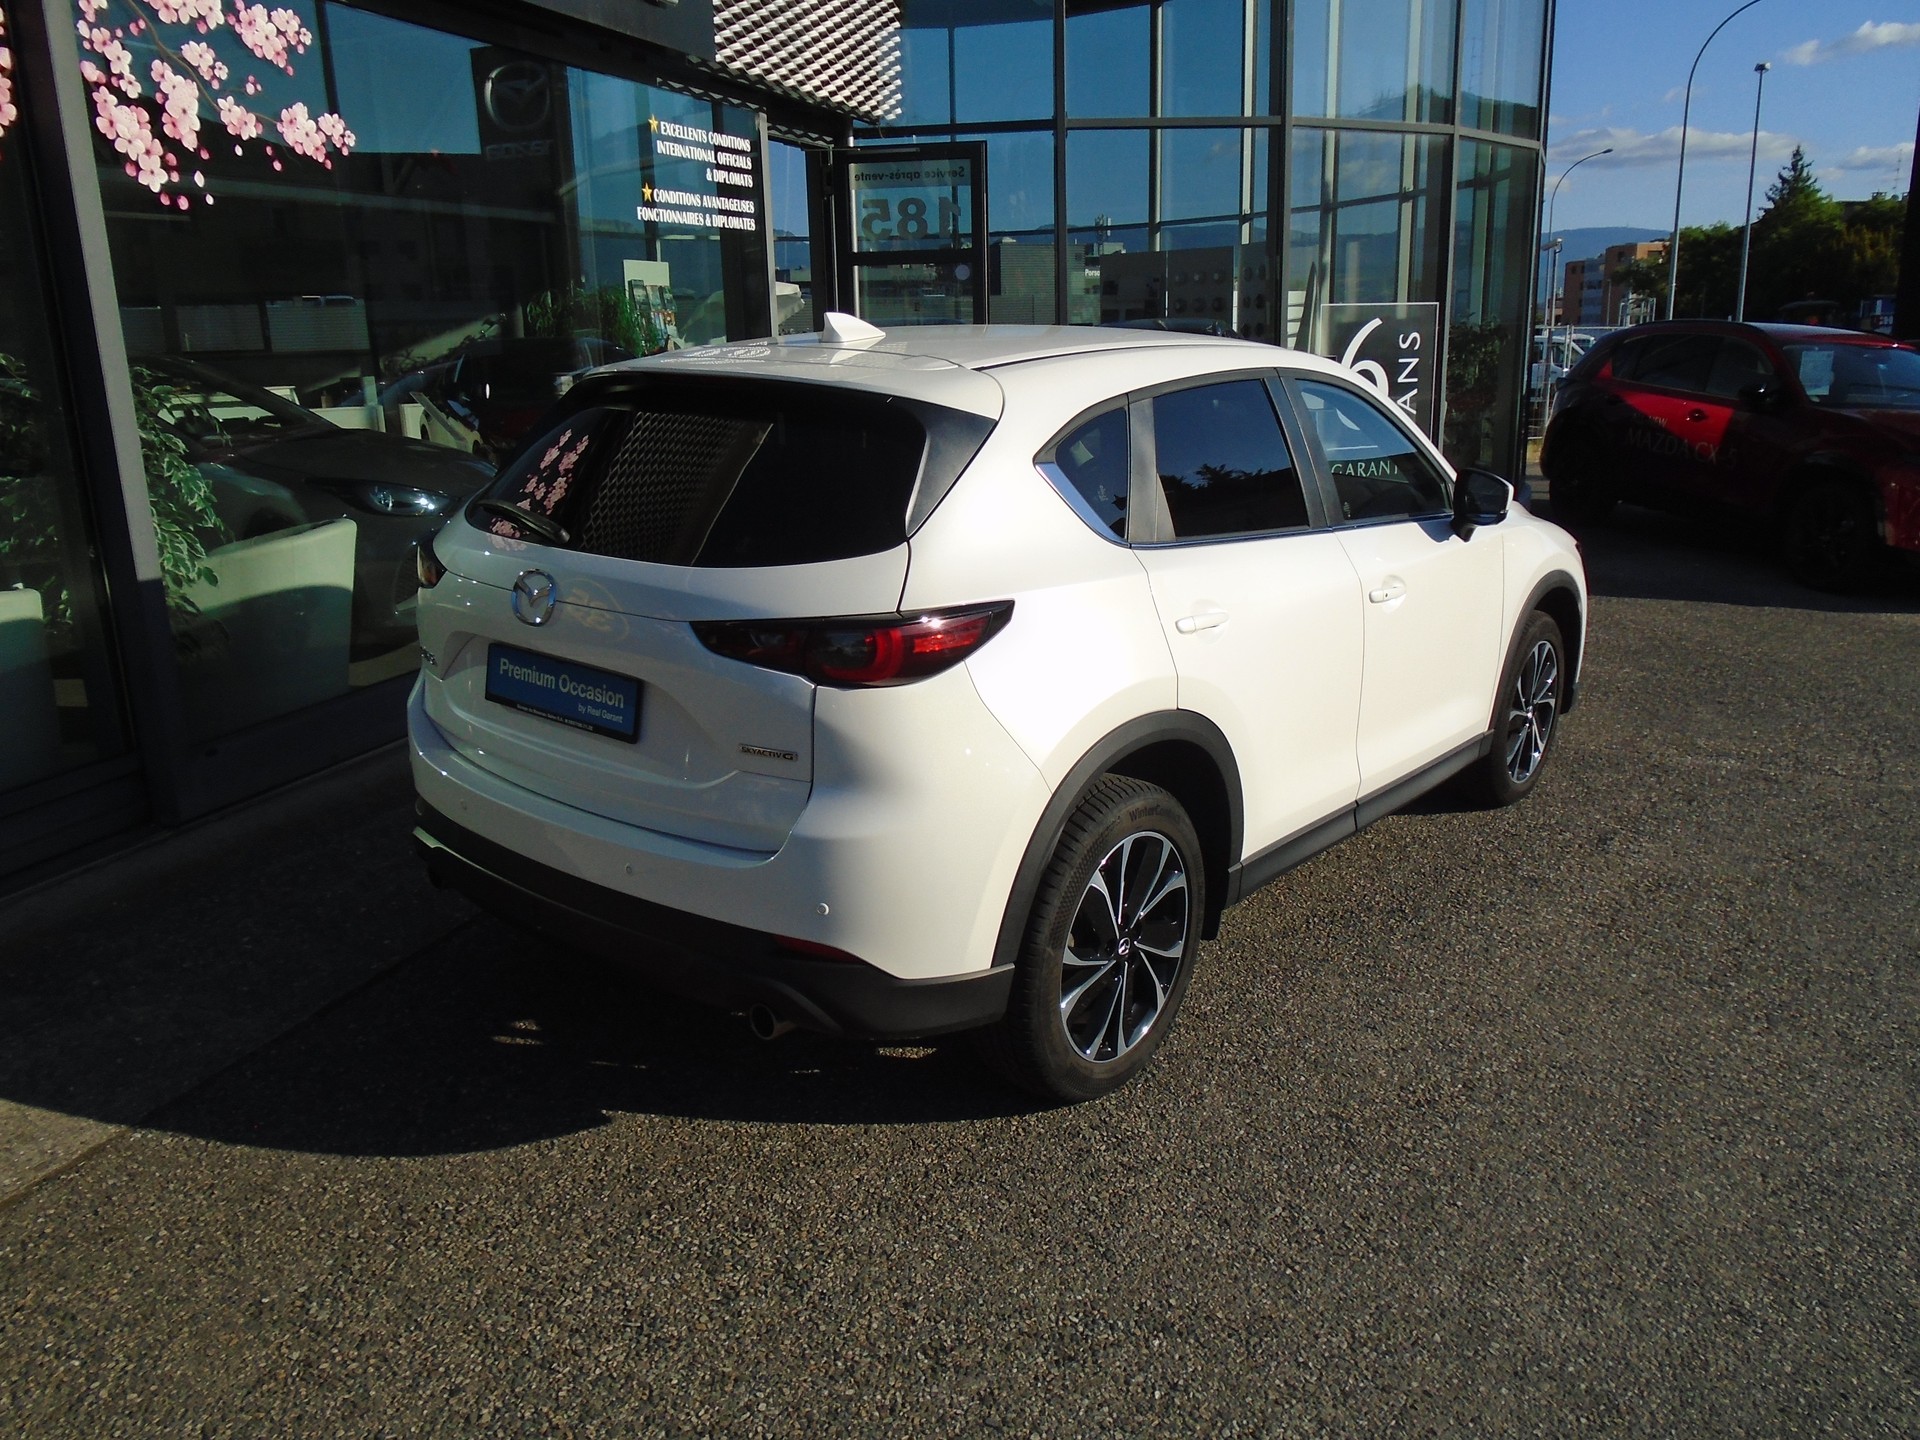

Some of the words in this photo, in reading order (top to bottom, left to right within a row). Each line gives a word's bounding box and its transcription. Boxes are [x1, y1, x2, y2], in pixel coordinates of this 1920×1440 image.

[660, 121, 707, 144] EXCELLENTS
[708, 131, 751, 152] CONDITIONS
[656, 140, 716, 164] INTERNATIONAL
[717, 151, 752, 170] OFFICIALS
[705, 168, 712, 181] &
[713, 169, 753, 188] DIPLOMATS
[653, 188, 701, 207] CONDITIONS
[702, 195, 755, 213] AVANTAGEUSES
[636, 206, 704, 226] FONCTIONNAIRES
[705, 213, 711, 227] &
[712, 214, 756, 231] DIPLOMATES
[1397, 331, 1421, 415] ANS
[1625, 427, 1689, 460] MAZDA
[499, 657, 556, 689] Premium
[559, 674, 624, 709] Occasion
[578, 703, 587, 714] by
[587, 705, 602, 717] Real
[602, 709, 623, 724] Garant
[741, 746, 782, 759] SKYACTIV
